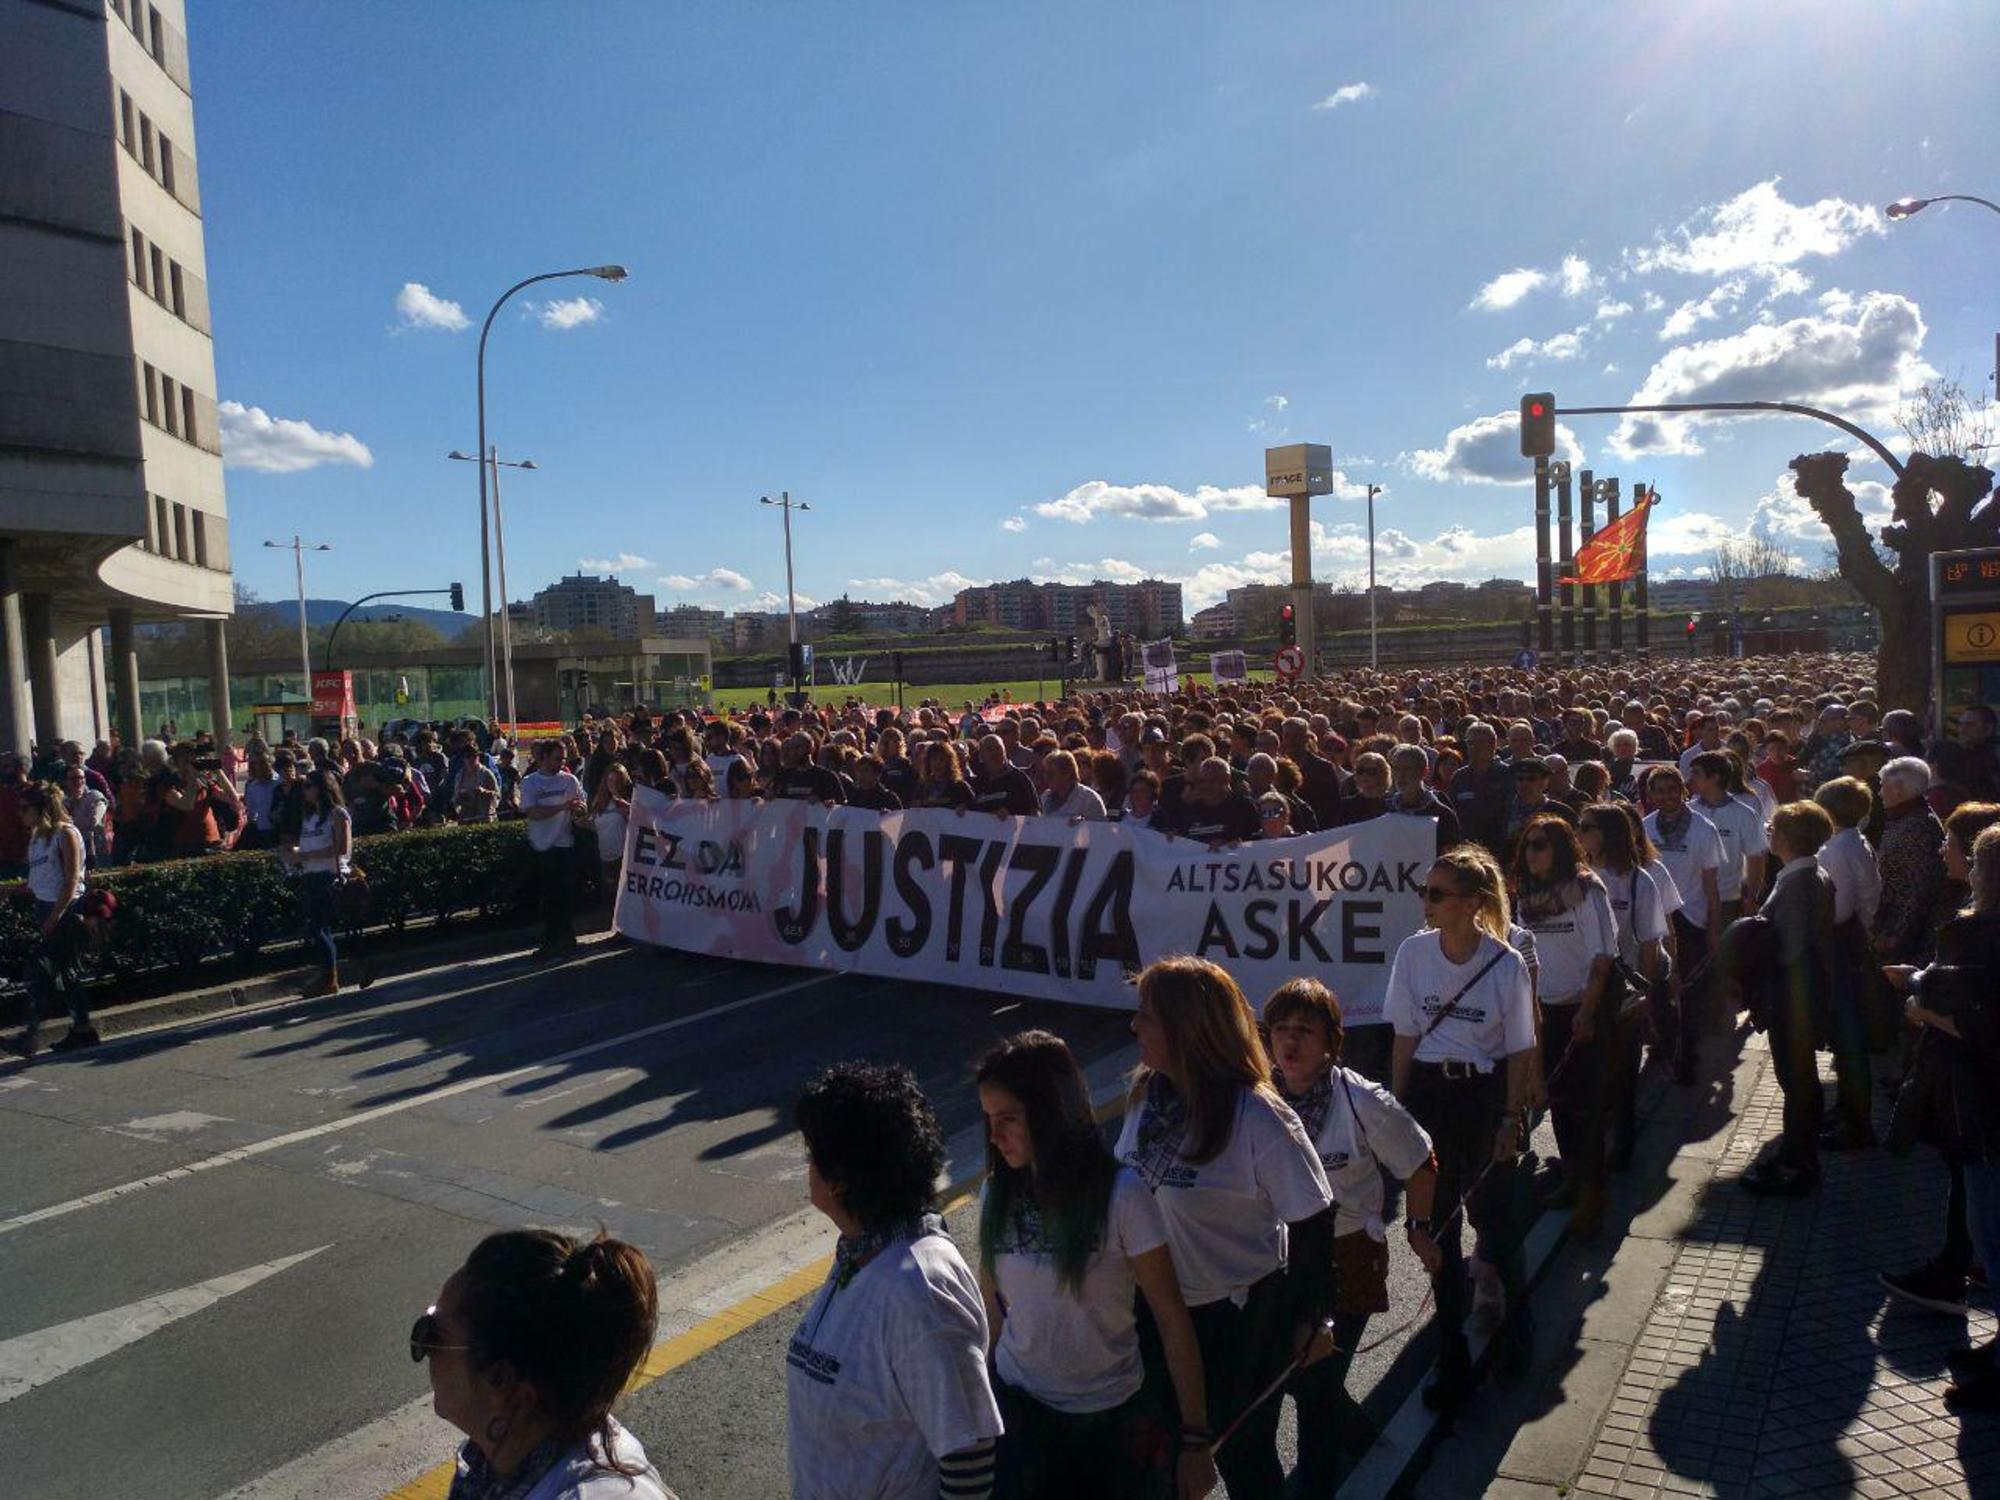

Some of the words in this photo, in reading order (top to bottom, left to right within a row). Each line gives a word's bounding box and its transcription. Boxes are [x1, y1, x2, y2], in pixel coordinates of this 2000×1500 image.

[315, 679, 342, 688] KFC
[634, 825, 686, 870] EZ
[694, 838, 746, 878] DA
[1167, 860, 1421, 893] ALTSASUKOAK
[774, 826, 1142, 981] JUSTIZIA
[1196, 899, 1386, 964] ASKE
